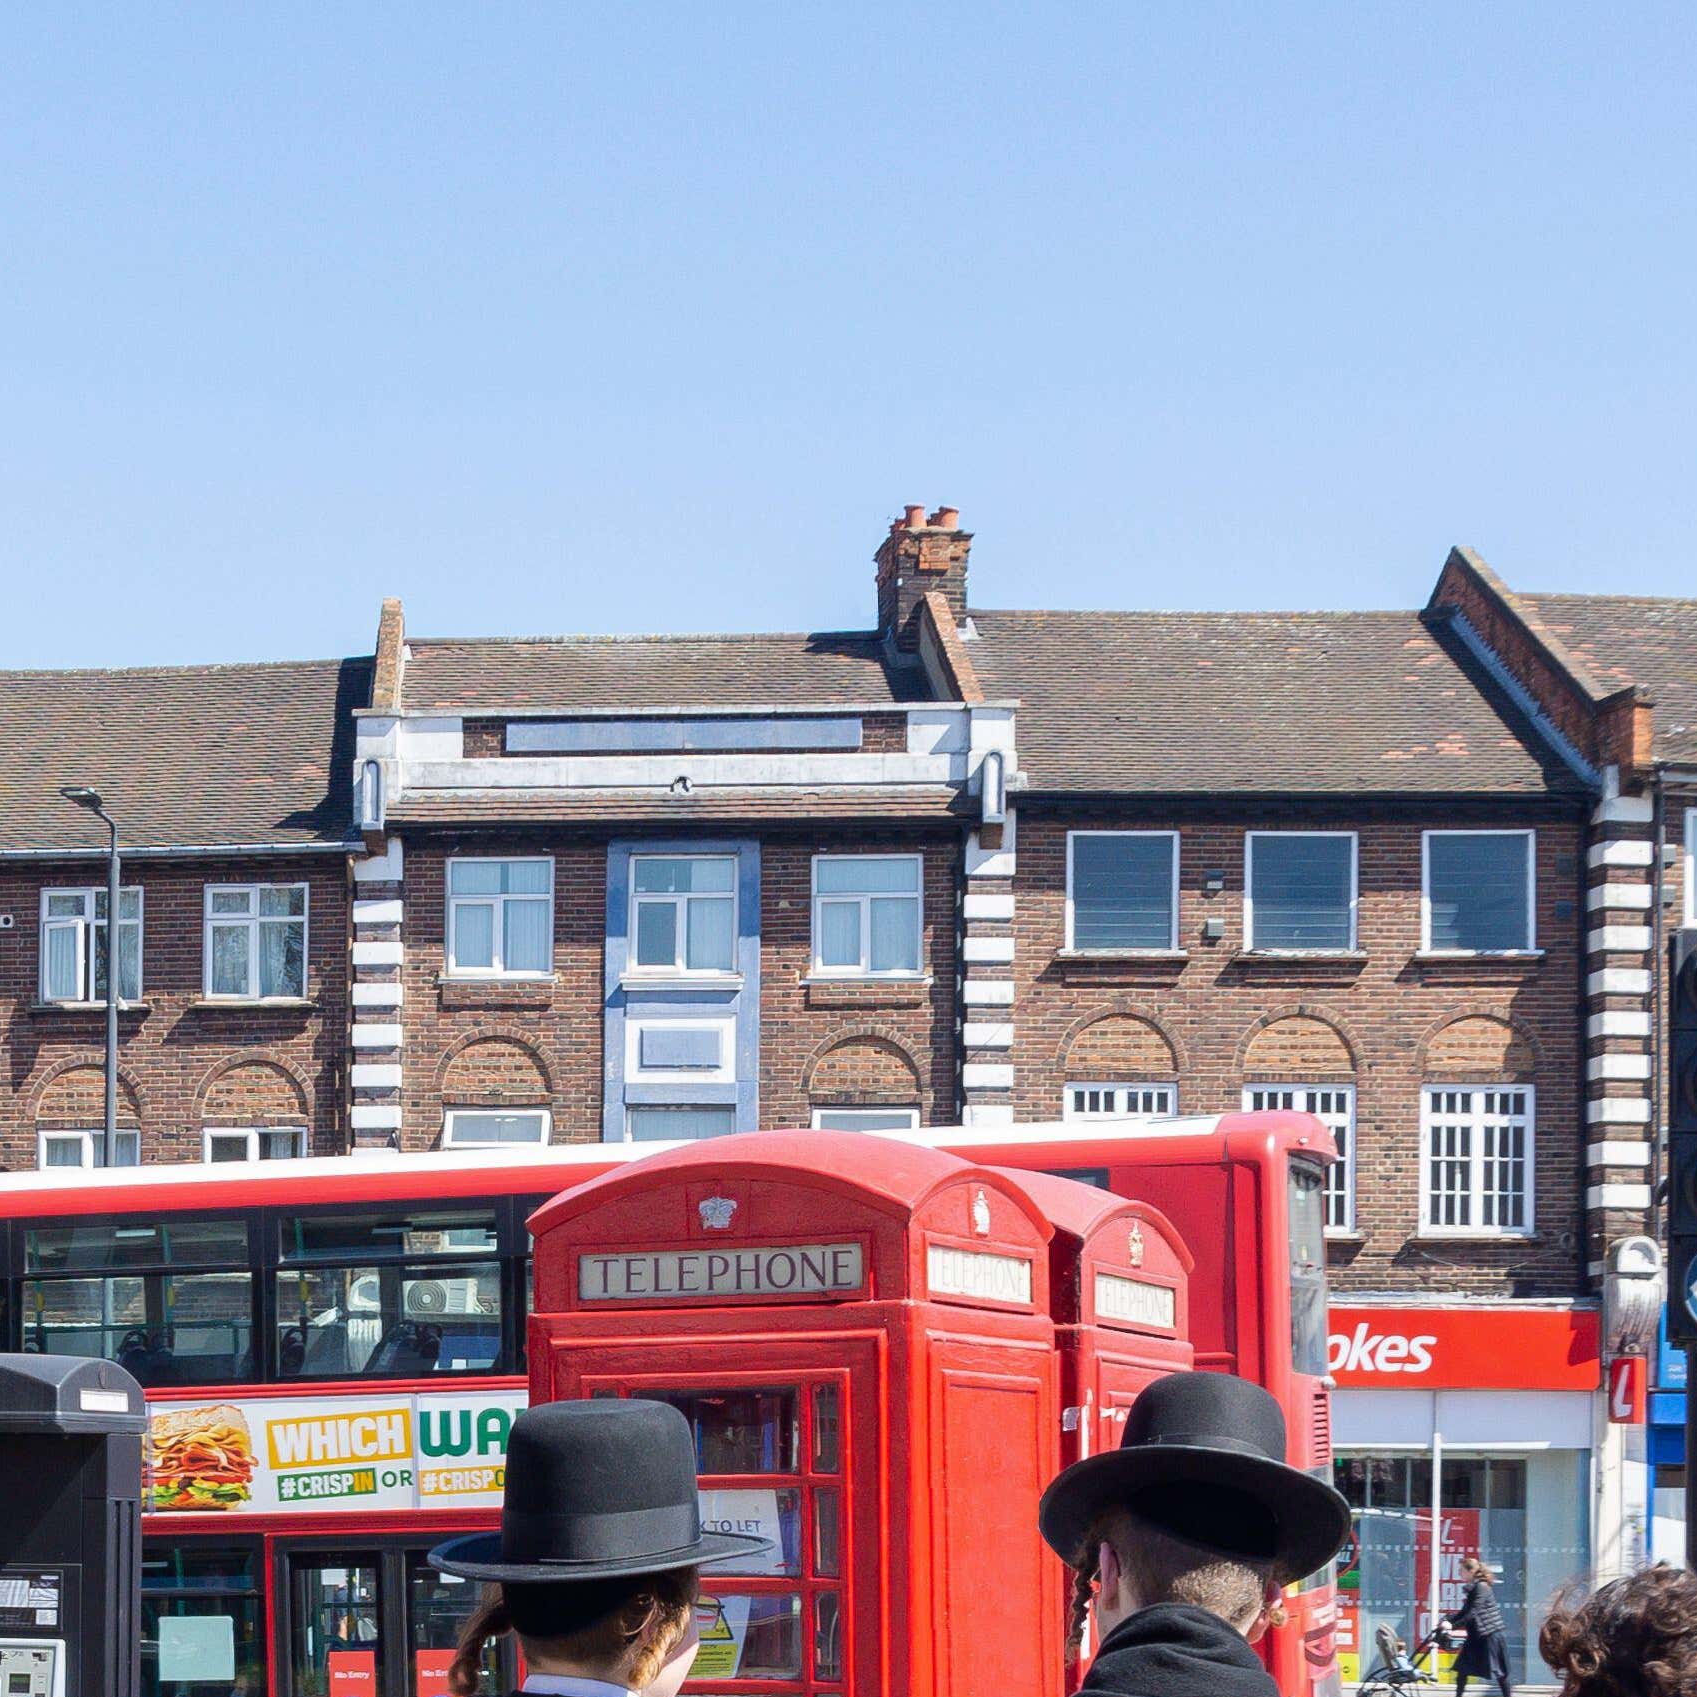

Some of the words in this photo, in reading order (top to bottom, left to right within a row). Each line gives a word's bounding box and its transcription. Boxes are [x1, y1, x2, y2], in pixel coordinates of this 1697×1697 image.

[593, 1250, 853, 1294] TELEPHONE
[931, 1249, 1027, 1298] TELEPHONE
[1099, 1277, 1171, 1324] TELEPHONE
[1327, 1323, 1438, 1373] okes
[271, 1413, 406, 1464] WHICH
[420, 1408, 528, 1458] WA
[280, 1471, 375, 1500] #CRISPIN
[381, 1470, 414, 1488] OR
[710, 1519, 733, 1533] TO
[737, 1519, 762, 1533] LET
[334, 1671, 347, 1679] No
[348, 1671, 370, 1680] Entry
